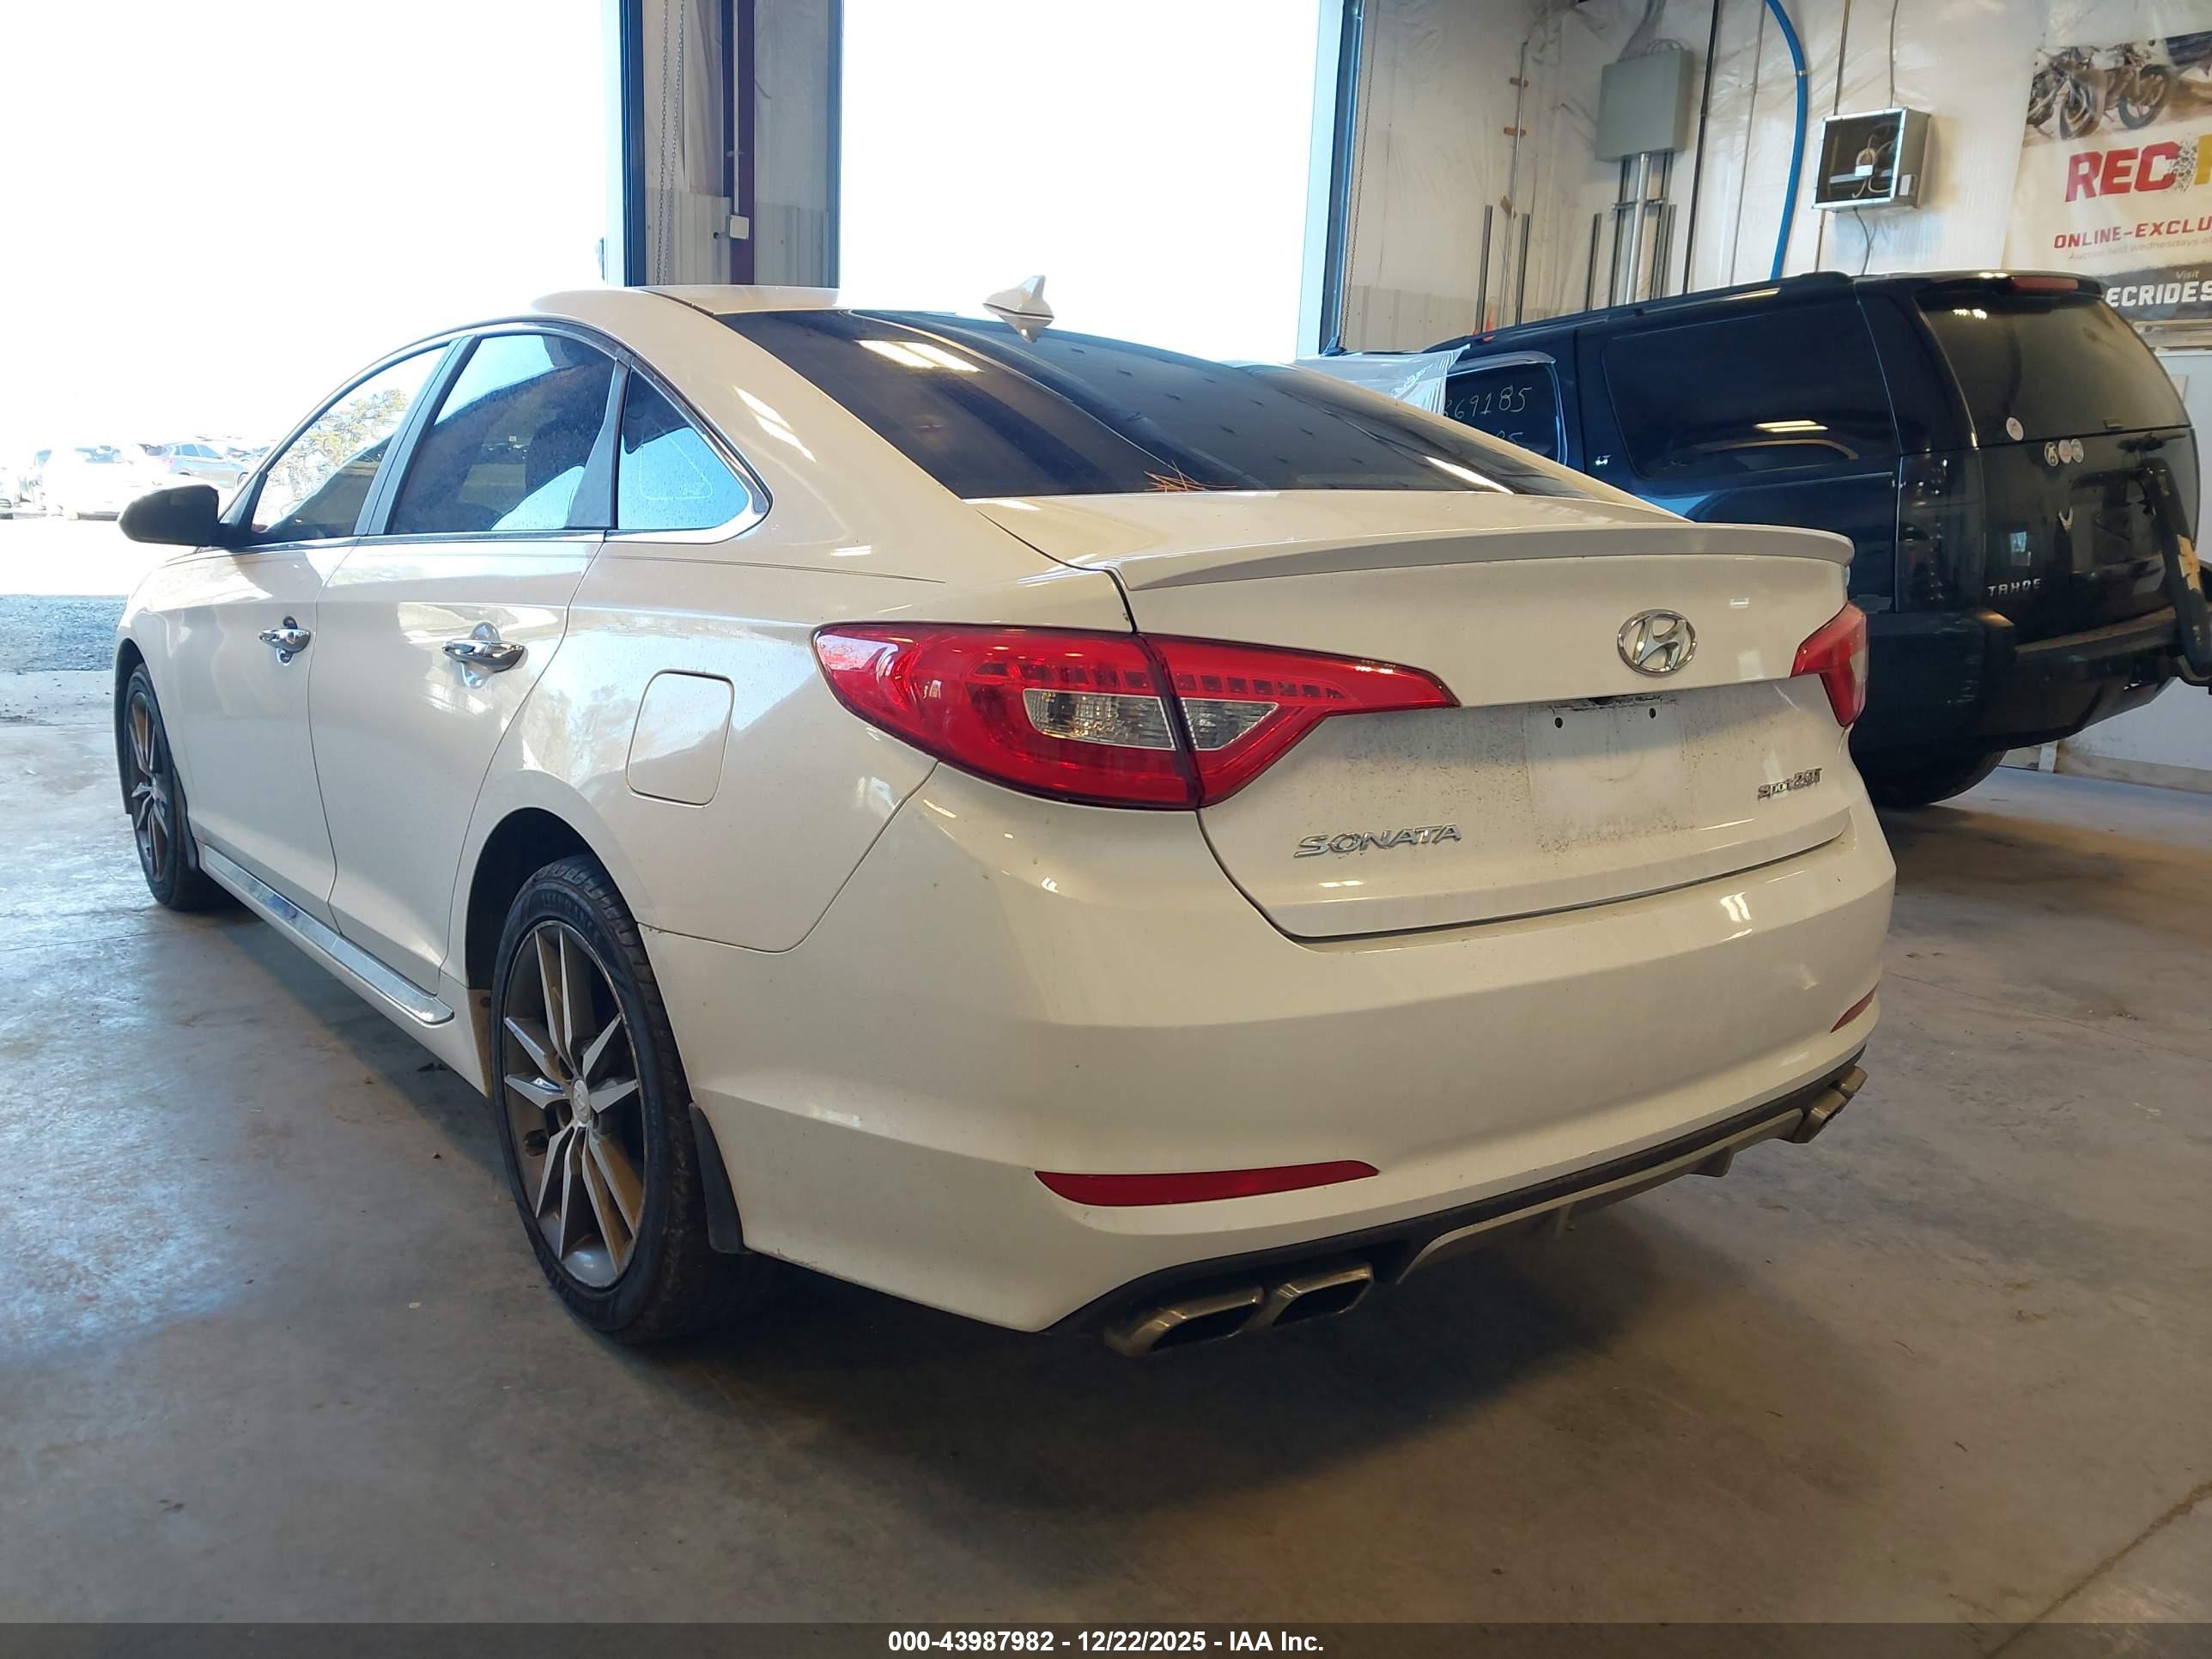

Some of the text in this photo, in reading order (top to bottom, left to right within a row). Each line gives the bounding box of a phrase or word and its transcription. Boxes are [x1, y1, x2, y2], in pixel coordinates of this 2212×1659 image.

[2175, 269, 2200, 280] Visit
[2105, 279, 2212, 307] ECRIDES
[1987, 578, 2042, 597] TAHOE
[1293, 823, 1462, 858] SONATA
